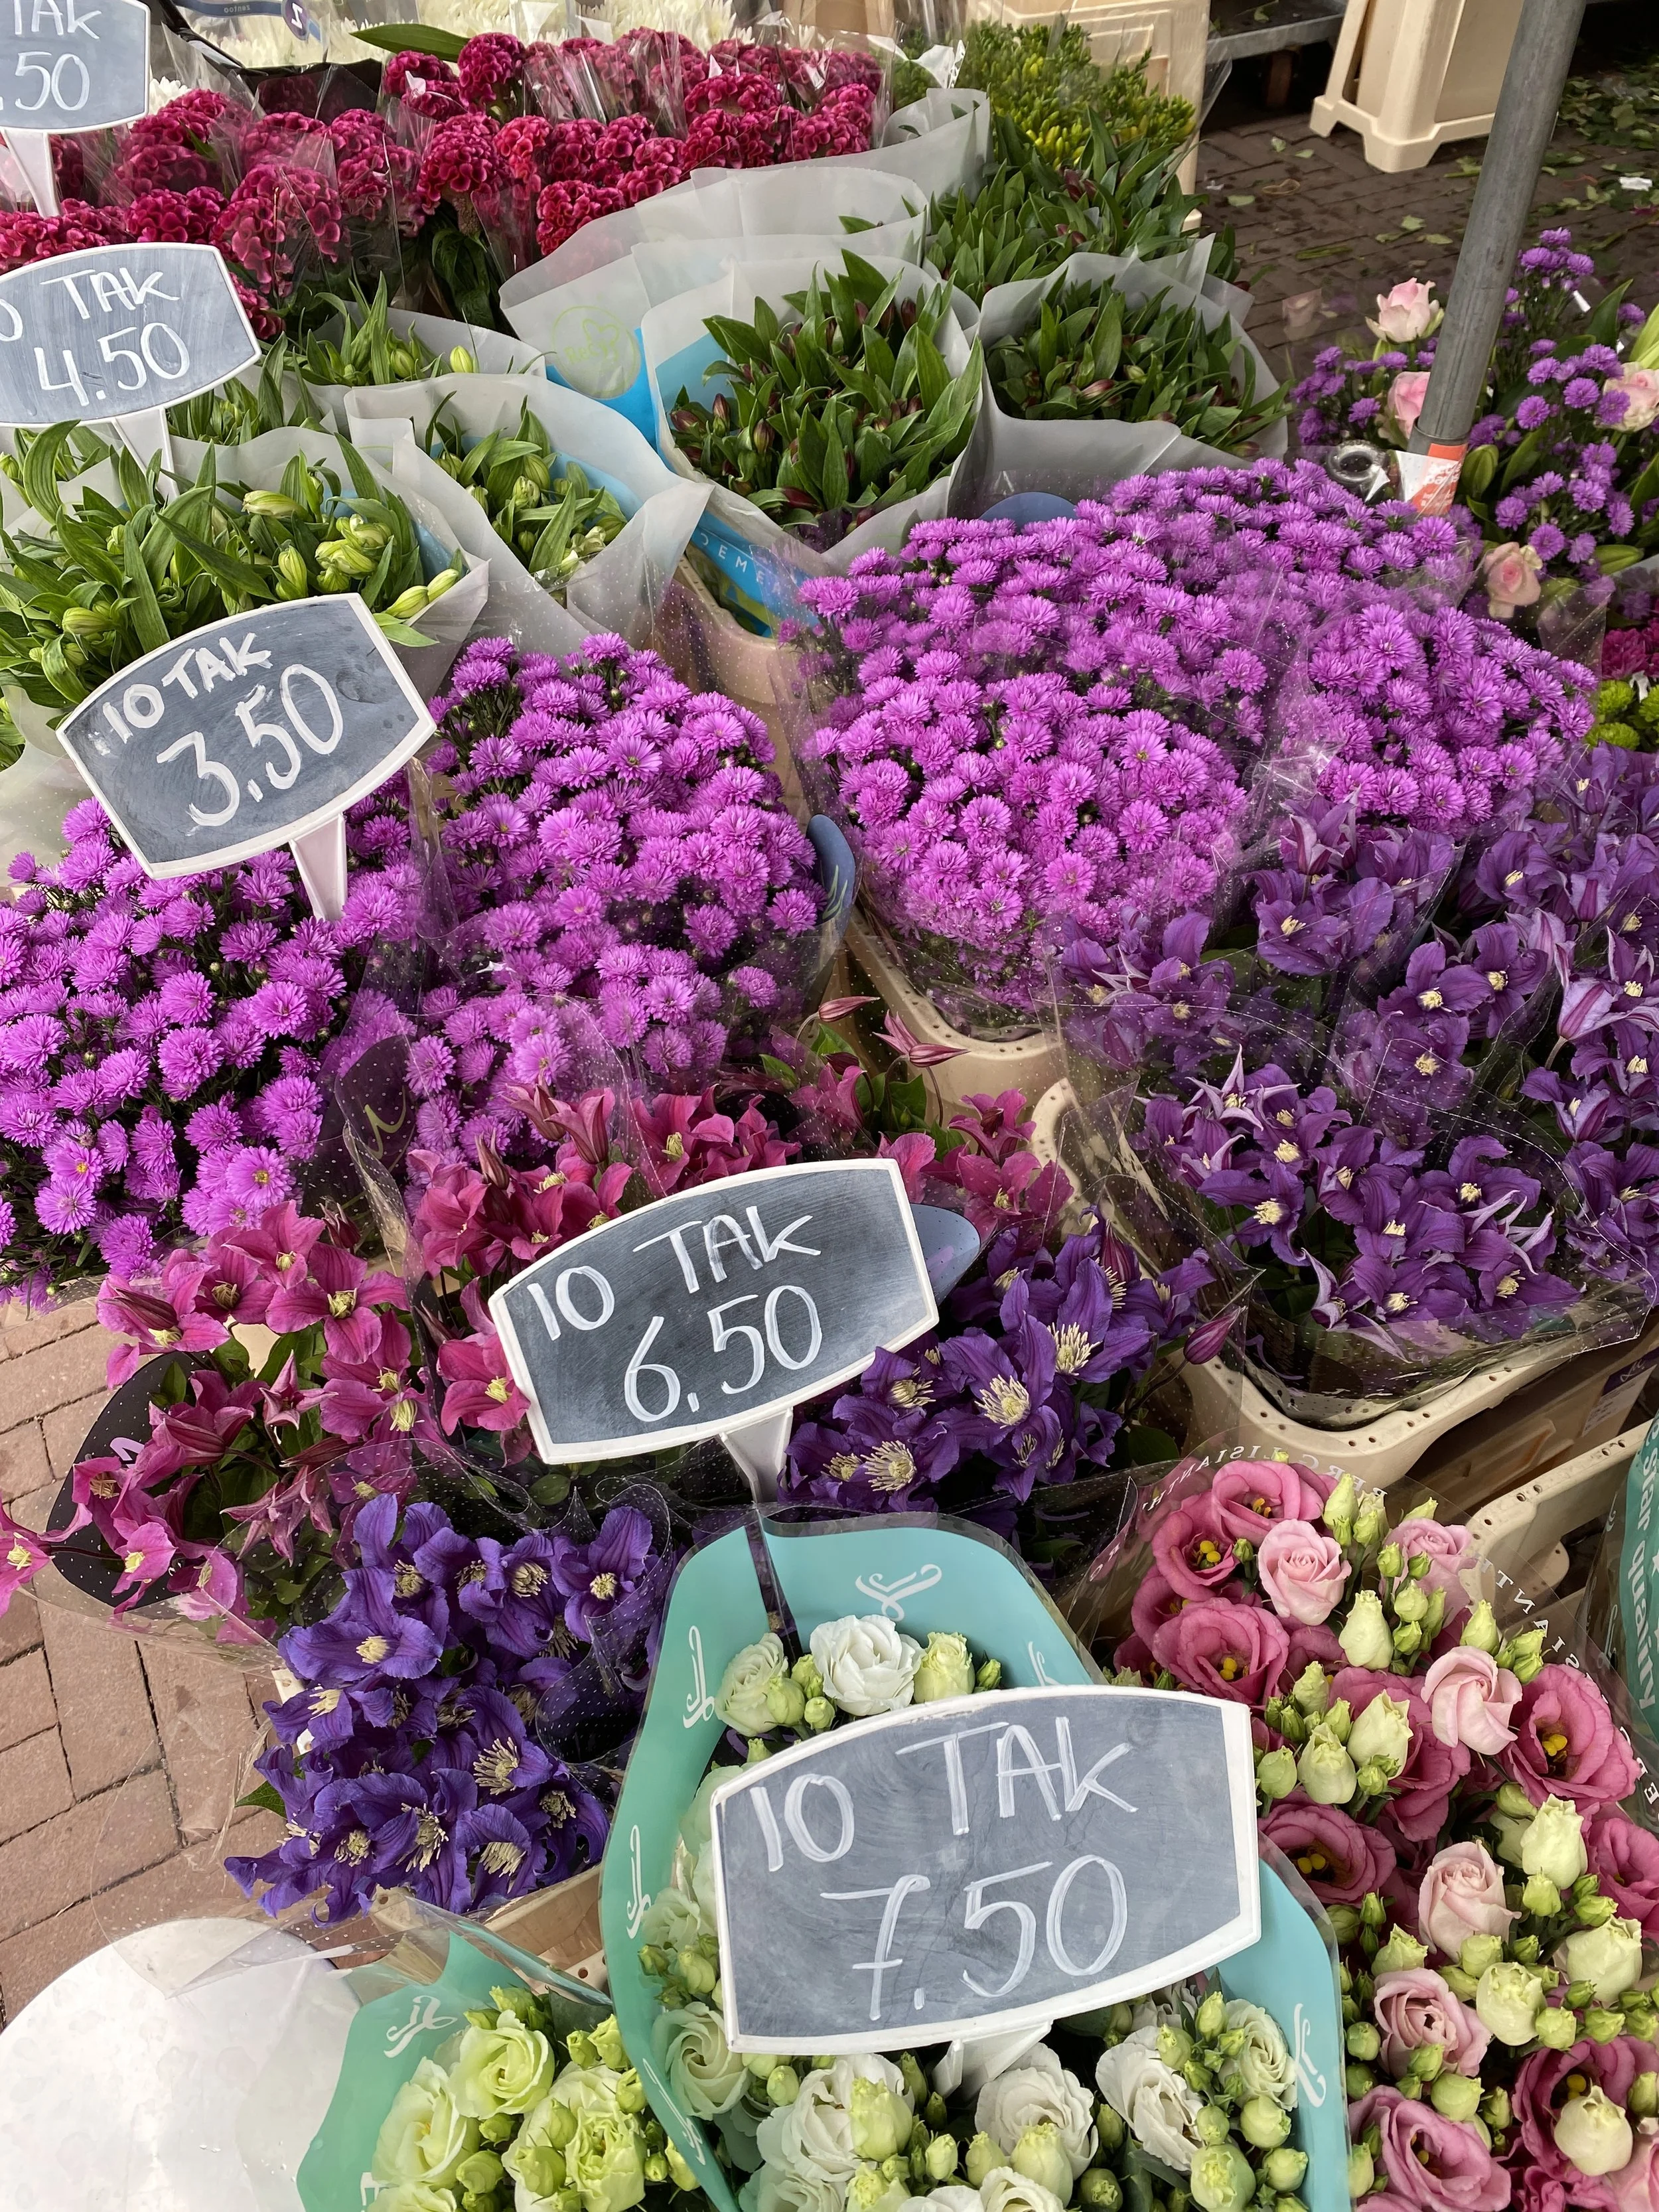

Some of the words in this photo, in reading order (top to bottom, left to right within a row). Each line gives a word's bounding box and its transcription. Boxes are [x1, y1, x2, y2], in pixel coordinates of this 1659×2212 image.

[40, 267, 180, 319] TAK
[34, 323, 190, 406] 4.50
[102, 684, 165, 743] 10
[162, 632, 271, 699] TAK
[527, 1265, 614, 1341] 10
[632, 1206, 822, 1293] TAK
[1628, 1540, 1655, 1709] quality
[750, 1774, 855, 1872] 10
[895, 1716, 1139, 1835] TAK
